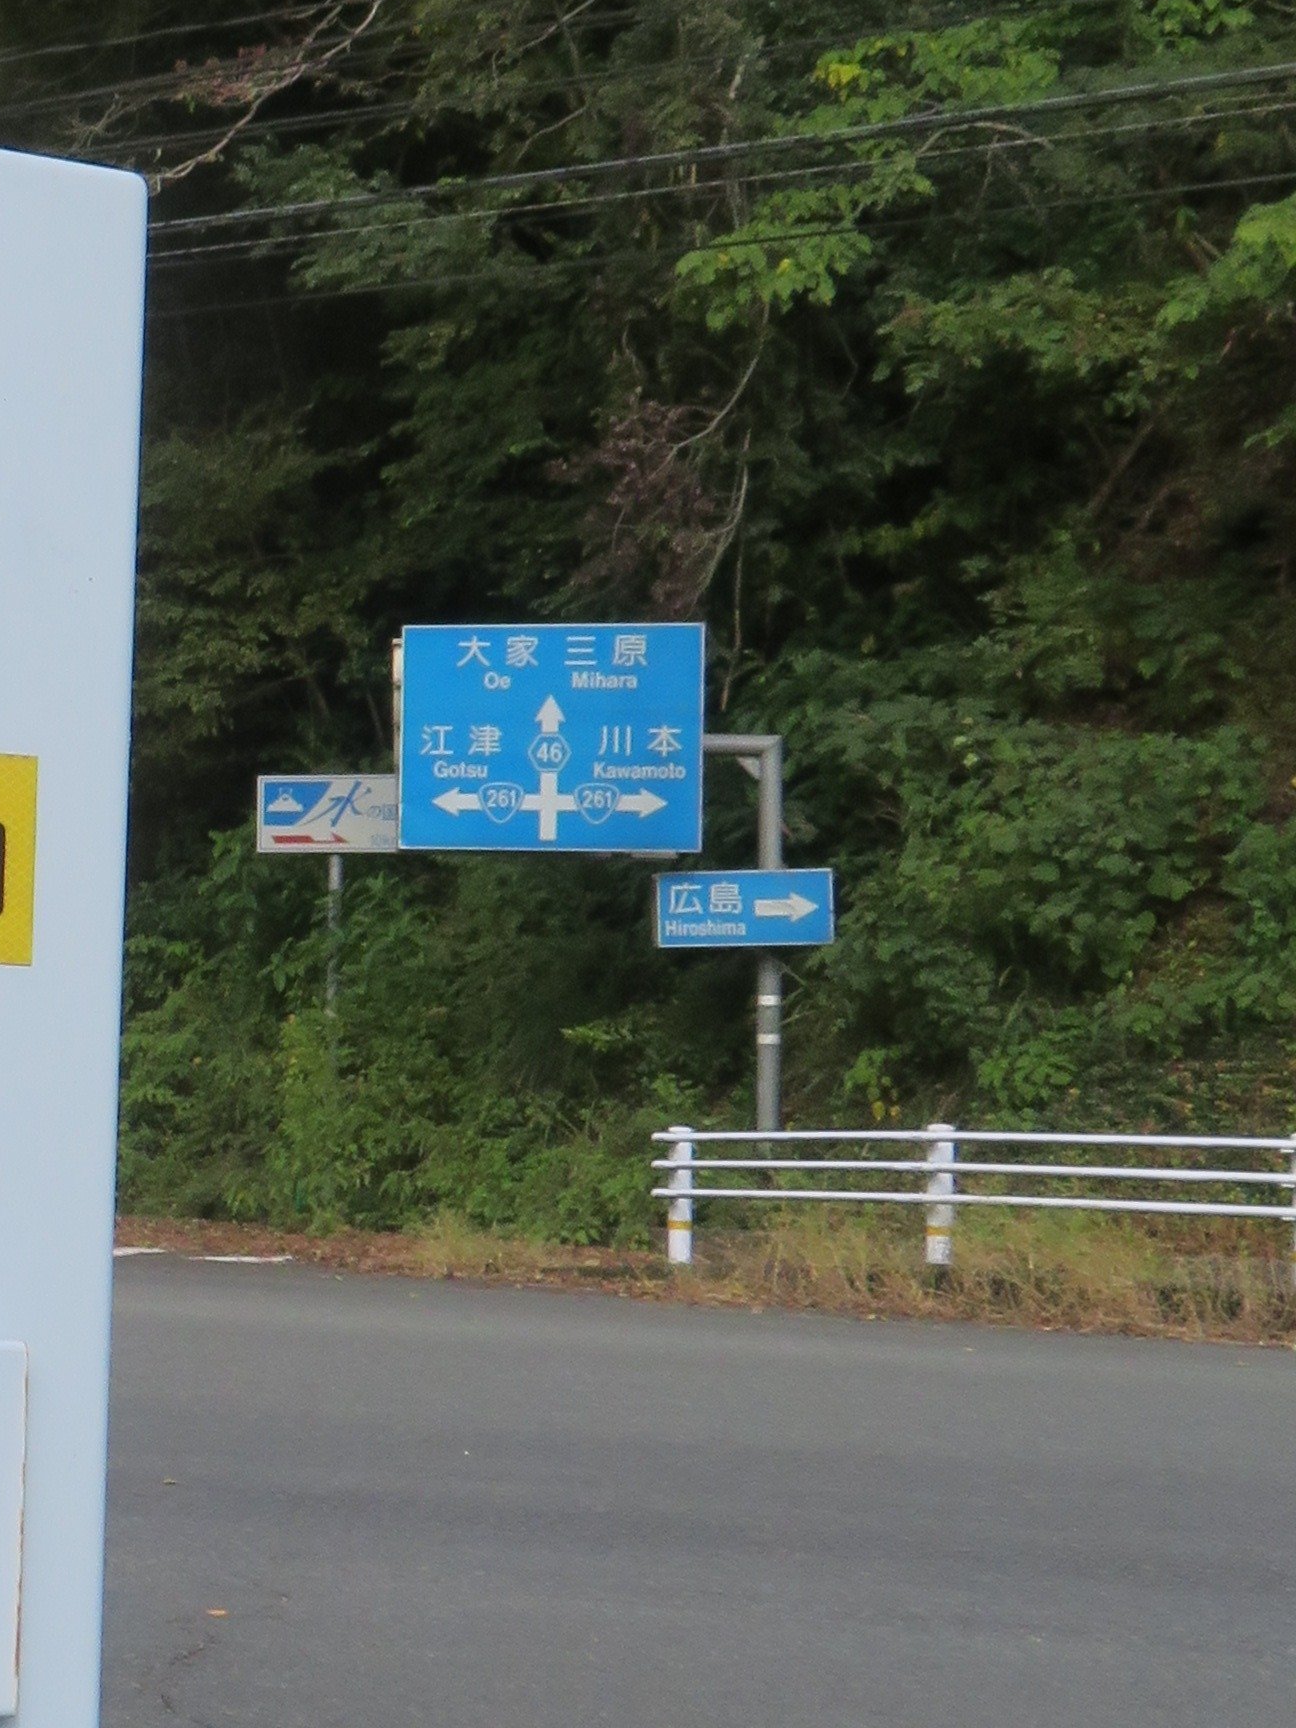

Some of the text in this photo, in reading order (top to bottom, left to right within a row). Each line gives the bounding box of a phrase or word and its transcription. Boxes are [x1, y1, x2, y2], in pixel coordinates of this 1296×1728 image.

[456, 634, 648, 667] 大家 三原
[483, 671, 638, 689] Oe Mihara
[420, 725, 502, 756] 江津
[598, 725, 683, 757] 川本
[536, 742, 563, 763] 46
[433, 761, 488, 779] Gotsu
[593, 762, 686, 779] Kawamoto
[486, 789, 516, 808] 261
[582, 789, 612, 808] 261
[669, 882, 743, 914] 広島
[664, 919, 747, 936] Hiroshima
